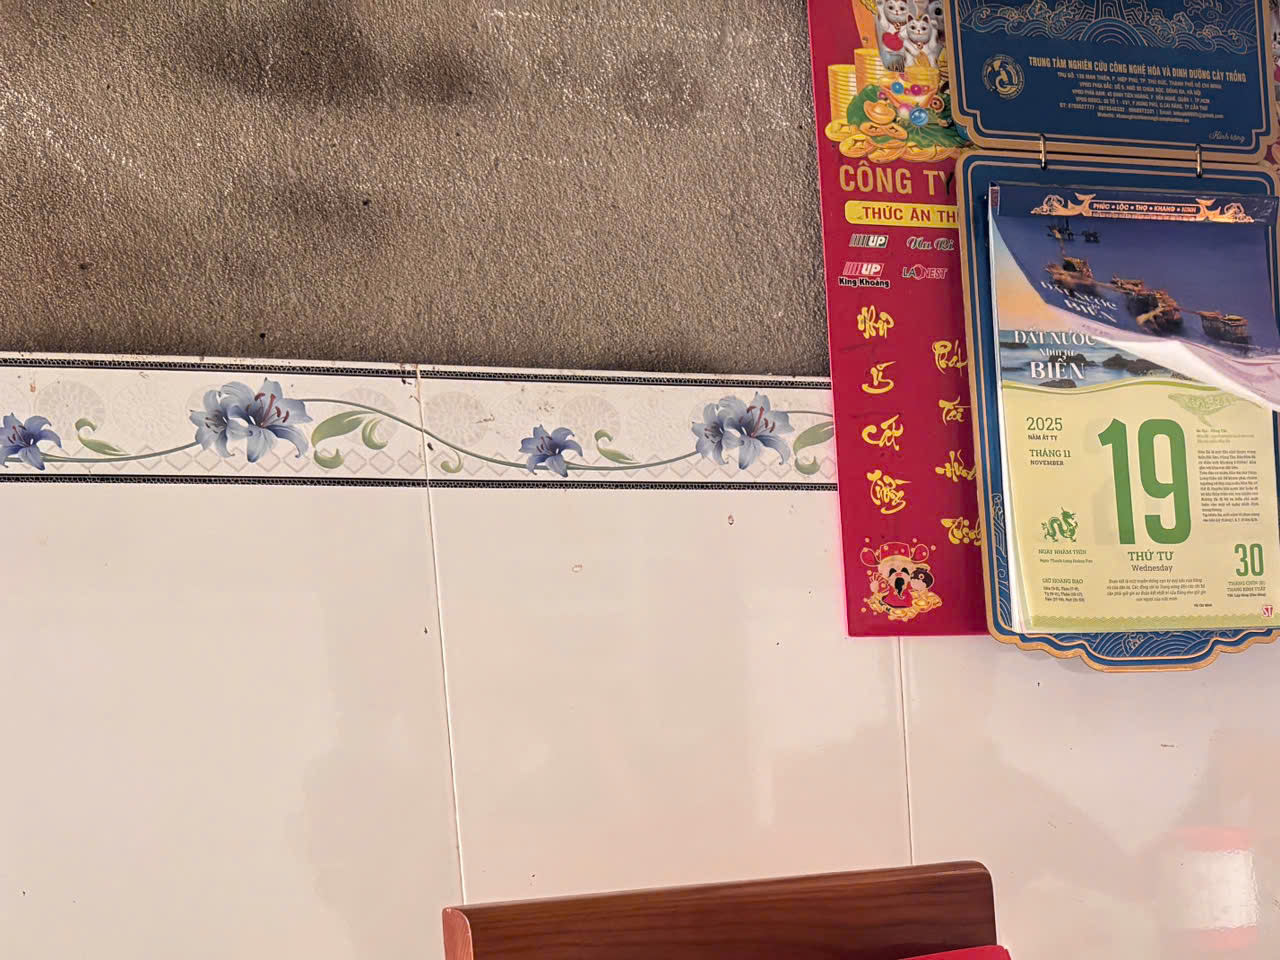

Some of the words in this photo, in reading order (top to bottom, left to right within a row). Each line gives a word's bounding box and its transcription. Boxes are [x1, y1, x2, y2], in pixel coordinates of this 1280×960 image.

[1028, 56, 1051, 68] TRUNG
[1109, 61, 1128, 74] CÔNG
[840, 160, 912, 195] CÔNG
[923, 169, 955, 196] TY
[862, 205, 904, 221] THỨC
[937, 210, 958, 223] TH
[839, 276, 858, 288] King
[859, 277, 891, 289] Khoáng
[1030, 355, 1086, 380] BIỂN
[1026, 416, 1063, 432] 2025
[1029, 448, 1062, 458] THÁNG
[1063, 449, 1072, 458] 11
[1097, 417, 1192, 545] 19
[1128, 549, 1154, 561] THỨ
[1156, 551, 1174, 561] TƯ
[1234, 543, 1264, 577] 30
[1131, 564, 1173, 573] Wednesday
[1263, 605, 1273, 617] ST
